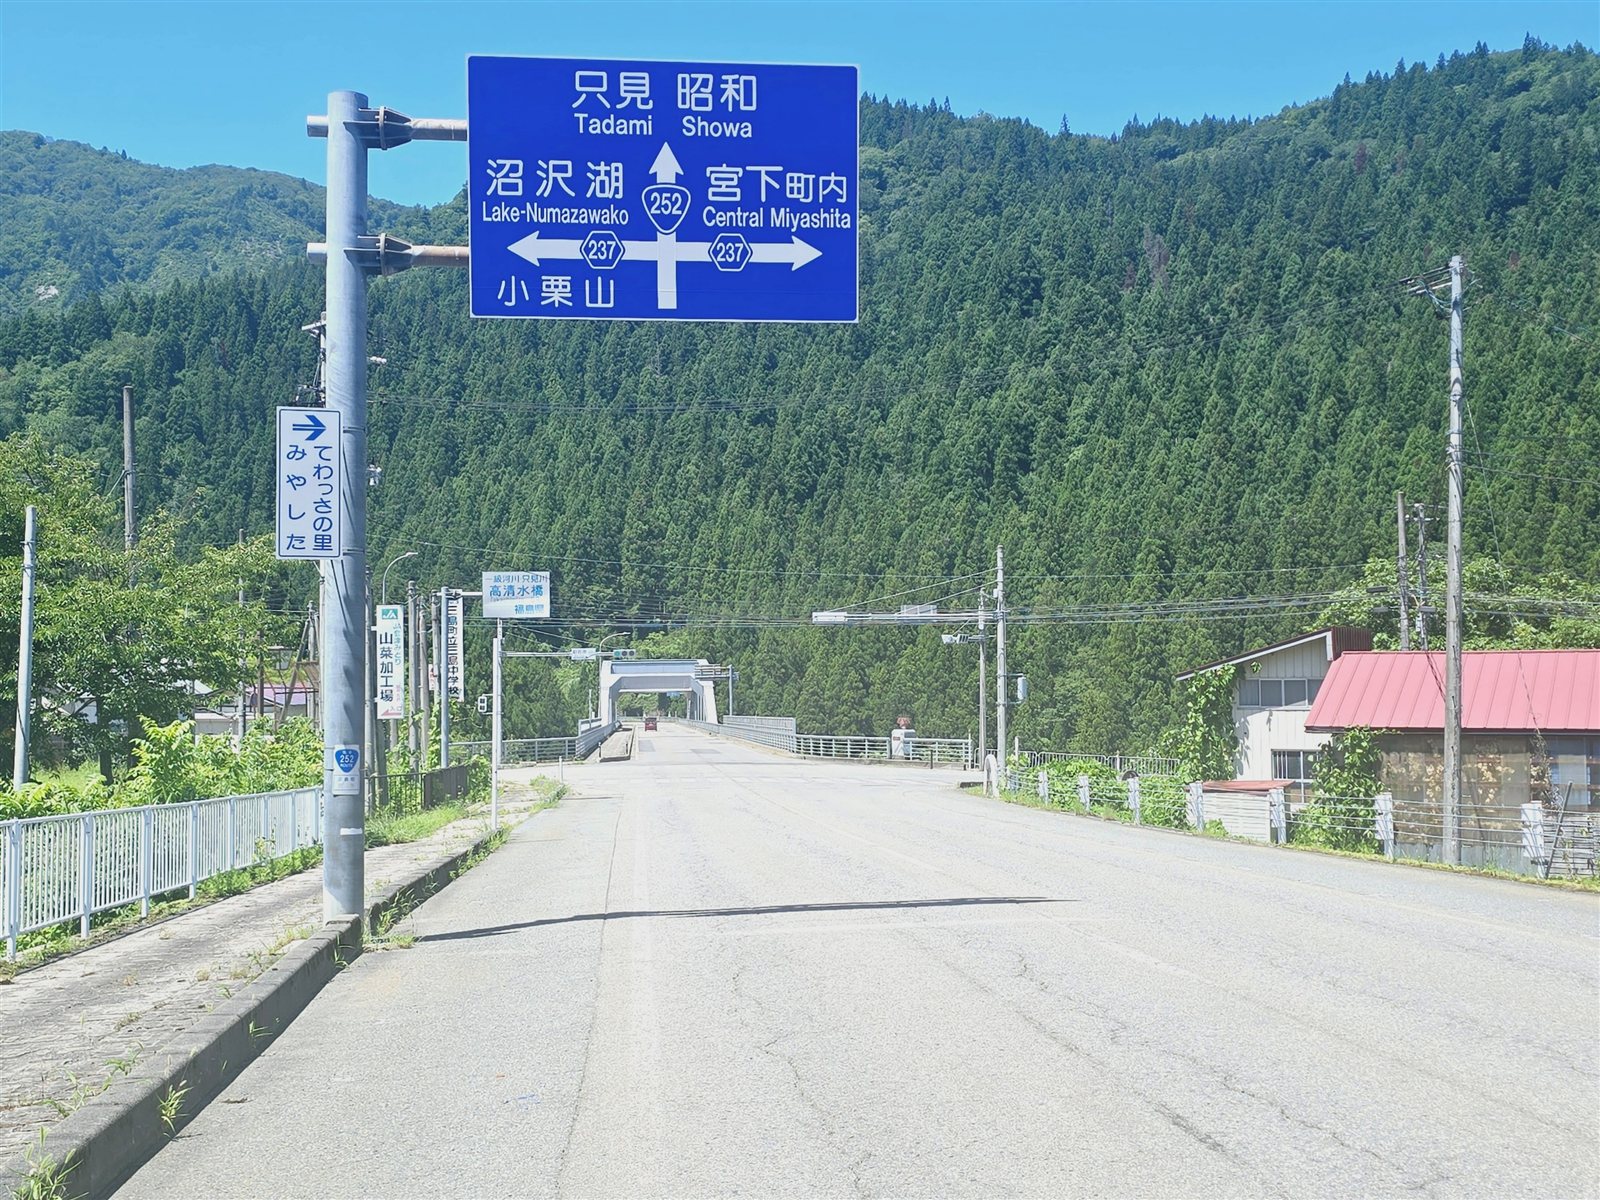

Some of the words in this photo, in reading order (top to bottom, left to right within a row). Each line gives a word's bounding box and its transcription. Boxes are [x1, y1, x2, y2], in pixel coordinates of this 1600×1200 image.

[571, 70, 653, 110] 只見
[677, 73, 757, 112] 昭和
[574, 113, 653, 136] Tadami
[682, 115, 752, 138] Showa
[486, 158, 624, 199] 沼沢湖
[706, 163, 847, 203] 宮下町内
[482, 202, 629, 226] Lake-Numazawako
[650, 192, 682, 216] 252
[702, 206, 764, 228] Central
[770, 207, 851, 232] Miyashita
[587, 239, 617, 260] 237
[716, 241, 745, 263] 237
[497, 275, 615, 308] 小栗山
[286, 444, 307, 550] みやした
[312, 445, 334, 551] てわっさの里
[489, 584, 543, 597] 高清水橋
[380, 631, 394, 702] 山菜加工場
[340, 754, 355, 763] 252
